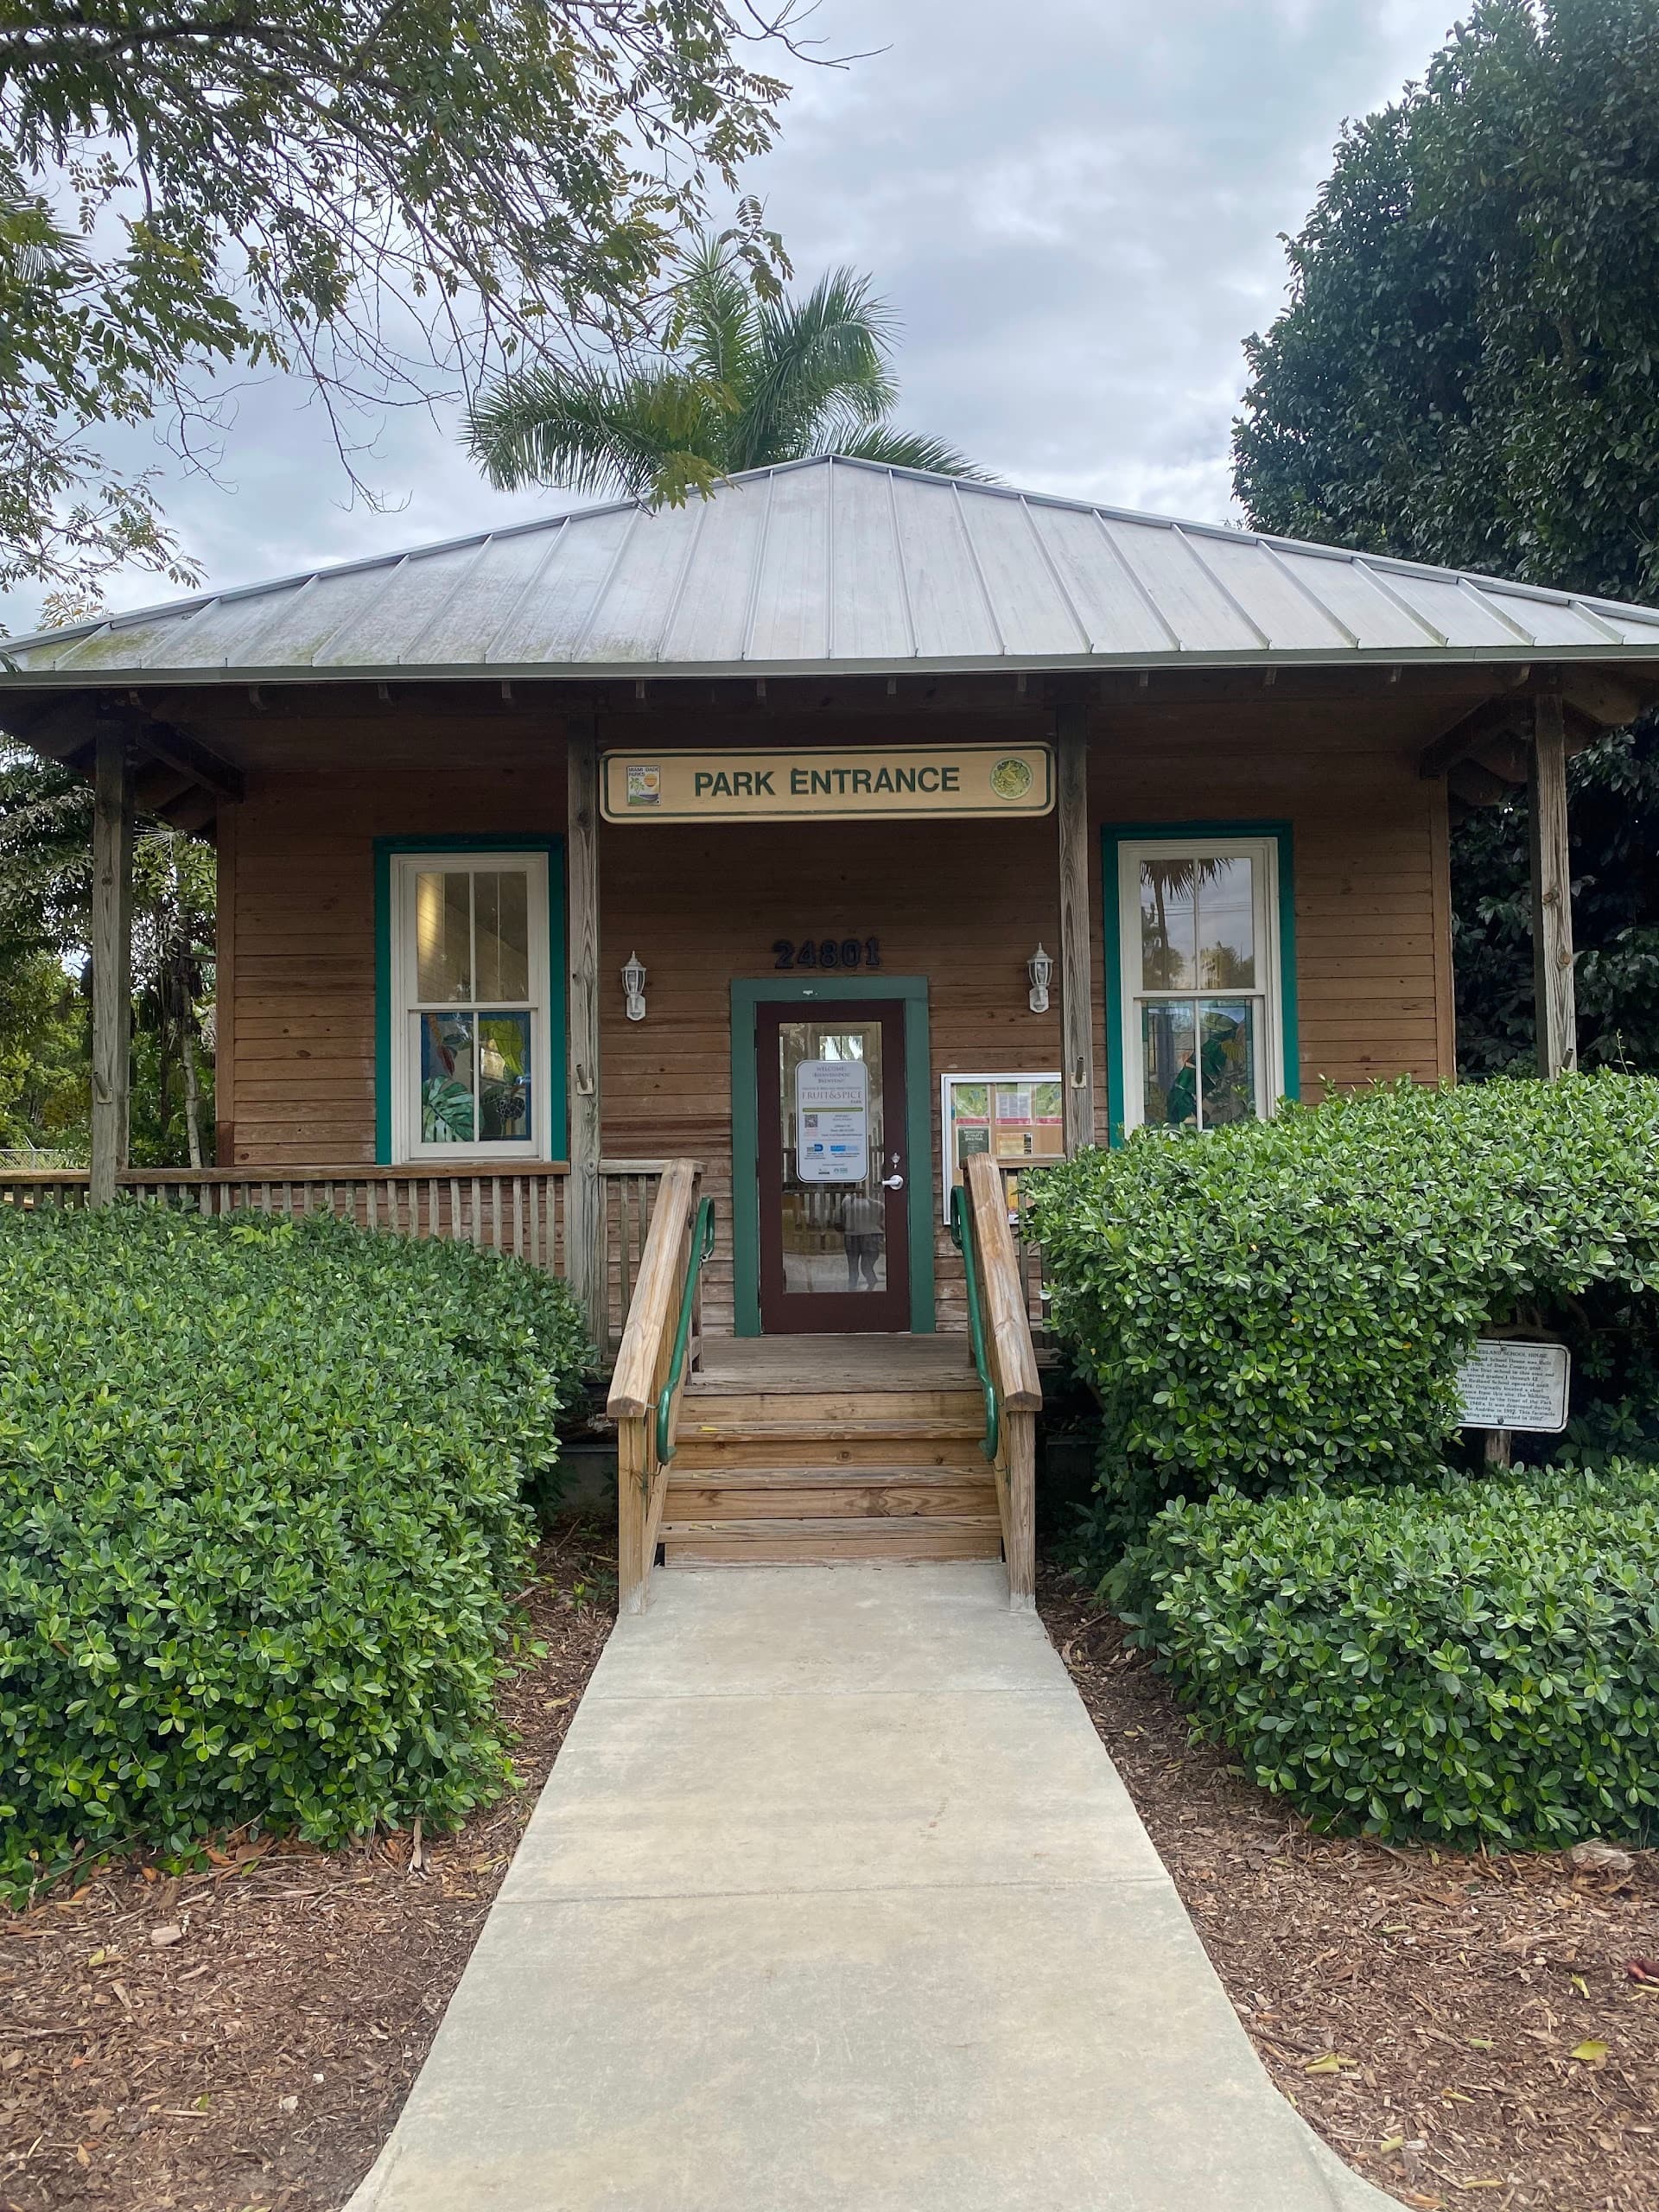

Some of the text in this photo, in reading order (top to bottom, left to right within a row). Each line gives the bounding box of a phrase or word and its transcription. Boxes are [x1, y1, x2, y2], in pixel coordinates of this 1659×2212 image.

[695, 766, 961, 798] PARK ENTRANCE
[772, 937, 881, 969] 24801
